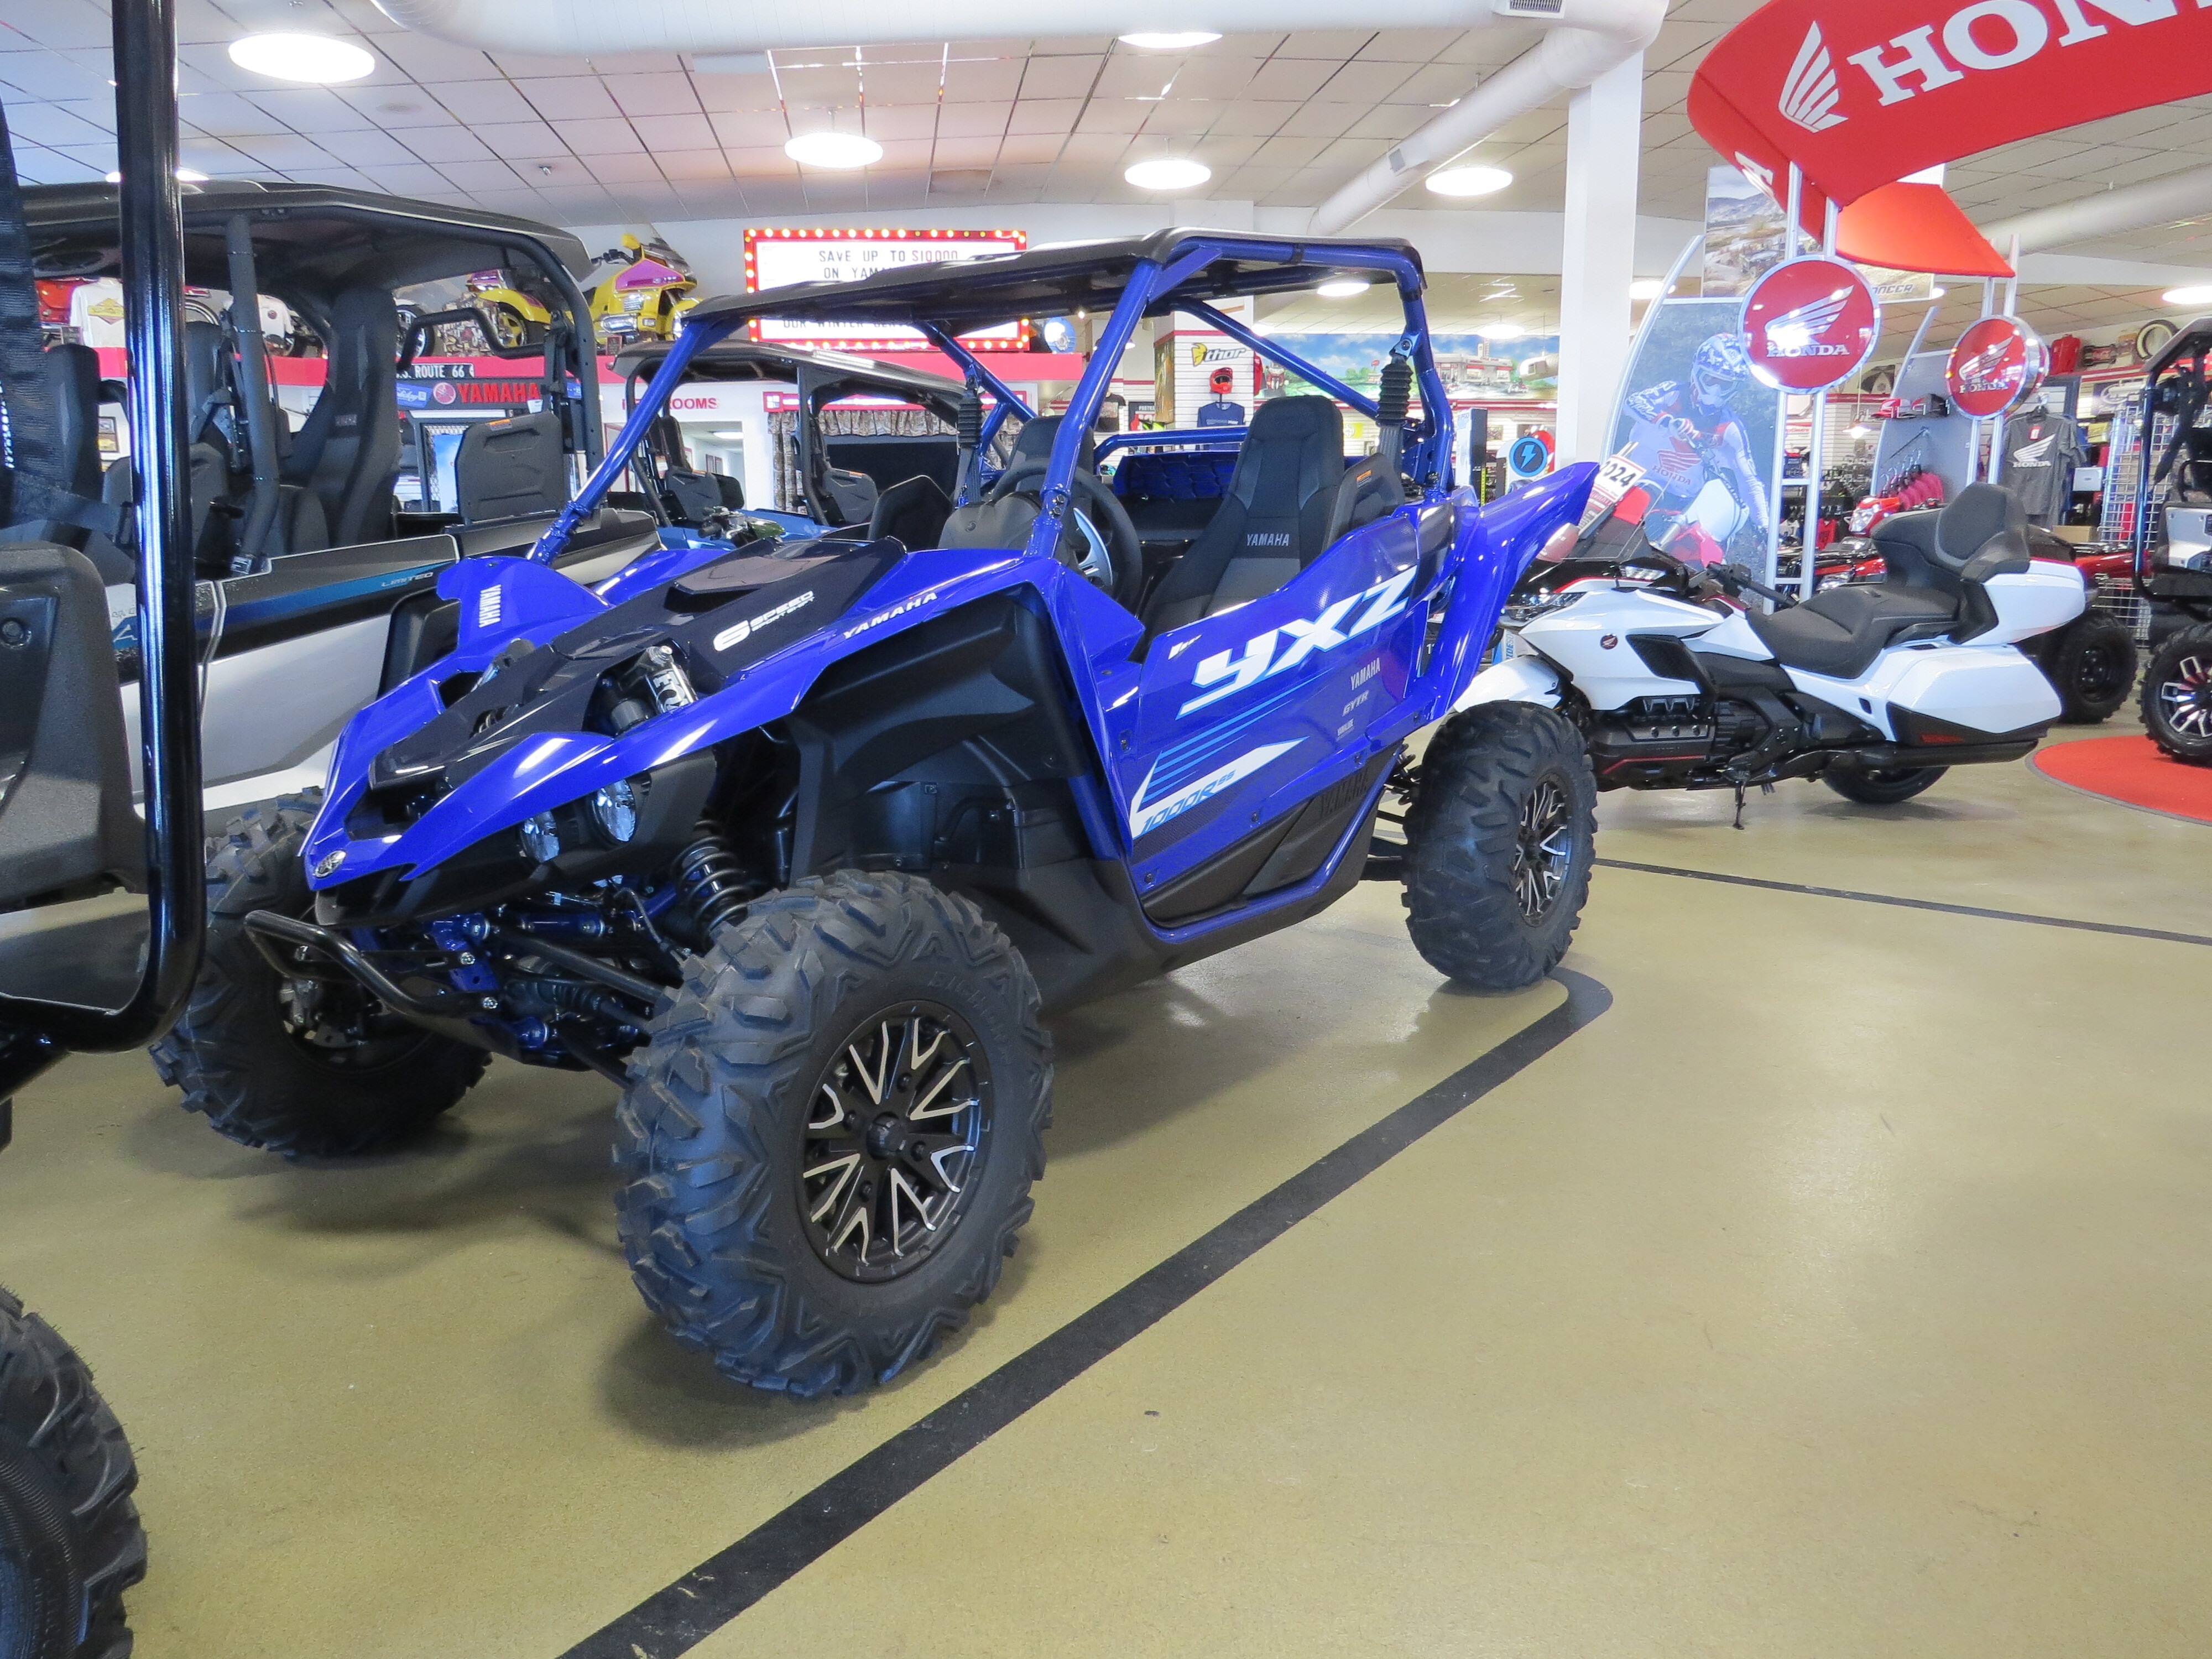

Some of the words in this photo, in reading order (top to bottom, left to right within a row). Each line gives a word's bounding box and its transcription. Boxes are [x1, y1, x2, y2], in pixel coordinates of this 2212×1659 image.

[1848, 0, 2212, 106] HON
[820, 251, 851, 262] SAVE
[863, 251, 878, 262] UP
[890, 251, 905, 262] TO
[824, 267, 839, 279] ON
[1767, 345, 1850, 357] HONDA
[415, 365, 446, 378] ROUTE
[452, 366, 465, 378] 66
[457, 383, 541, 403] YAMAHA
[1652, 465, 1691, 485] HONDA
[1247, 533, 1290, 546] YAMAHA
[478, 584, 502, 628] YAMAHA
[750, 590, 813, 628] SPEED
[843, 592, 938, 639] YAMAHA
[1350, 657, 1380, 691] YAMAHA
